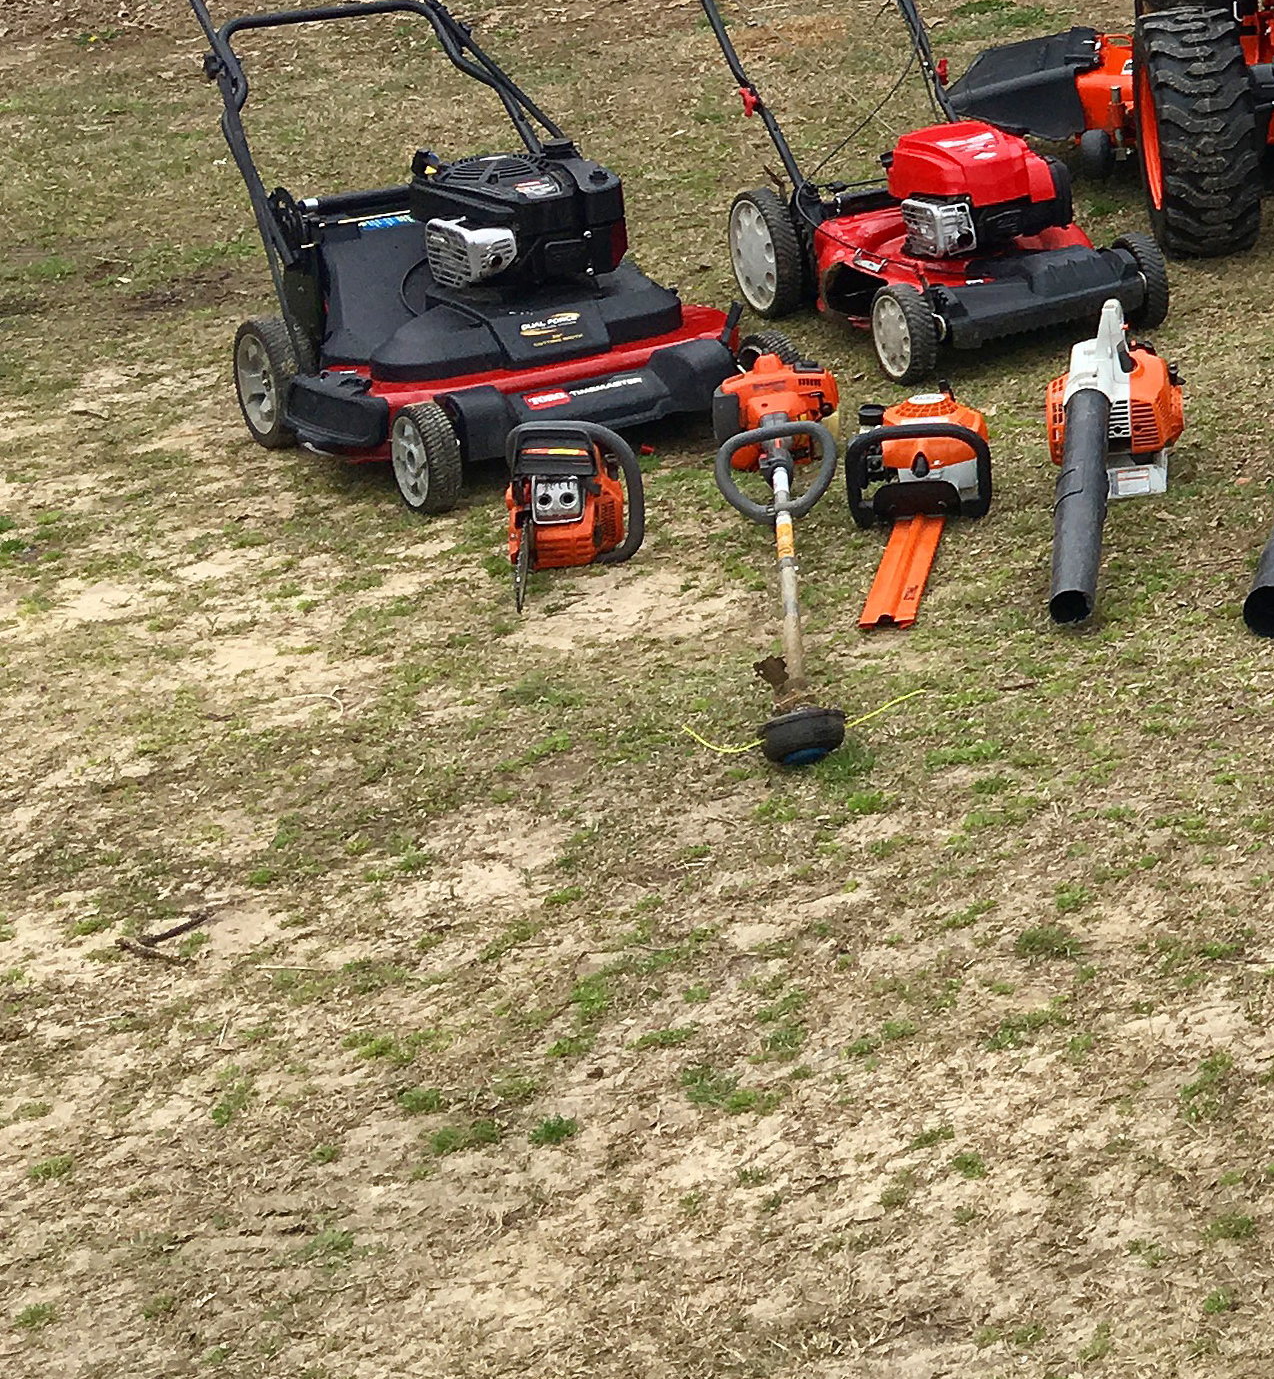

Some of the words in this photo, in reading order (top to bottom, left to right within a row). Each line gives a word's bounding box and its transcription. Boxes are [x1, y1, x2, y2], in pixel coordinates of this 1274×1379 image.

[521, 320, 546, 331] DUAL
[547, 315, 579, 326] FORCE
[527, 391, 568, 406] TORO
[568, 376, 643, 397] TIMEMASTER
